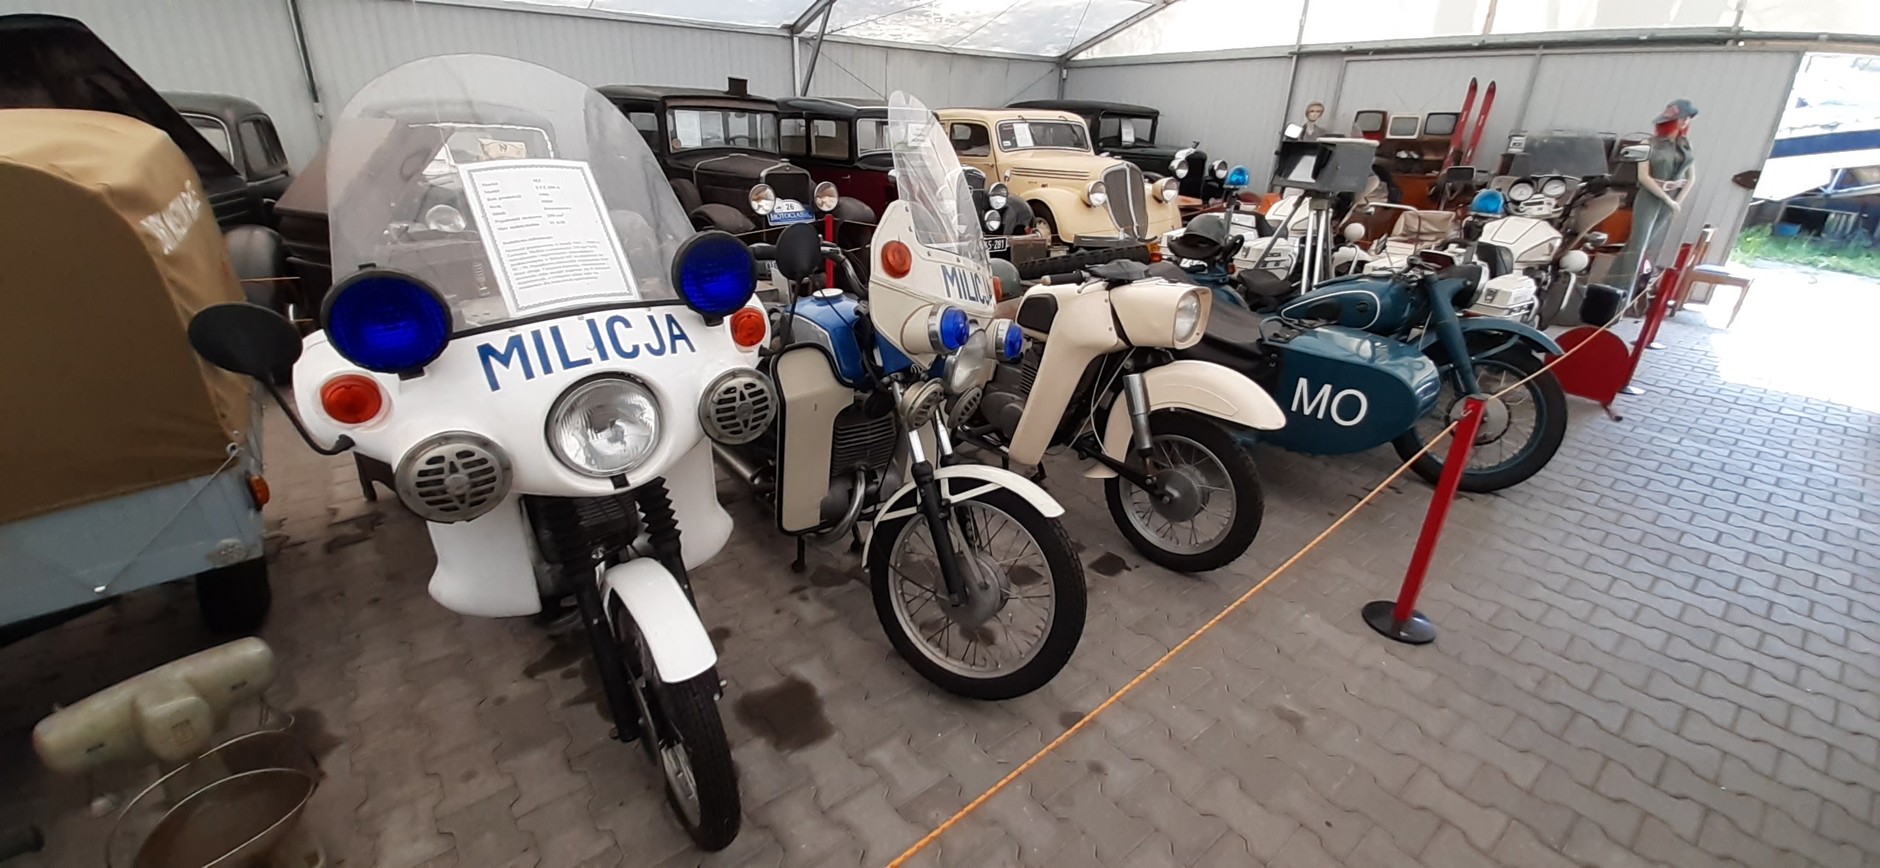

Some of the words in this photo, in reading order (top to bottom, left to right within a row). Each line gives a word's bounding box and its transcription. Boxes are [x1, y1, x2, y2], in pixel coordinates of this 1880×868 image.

[785, 203, 795, 211] 26
[476, 313, 696, 392] MILICJA
[1290, 377, 1368, 426] MO
